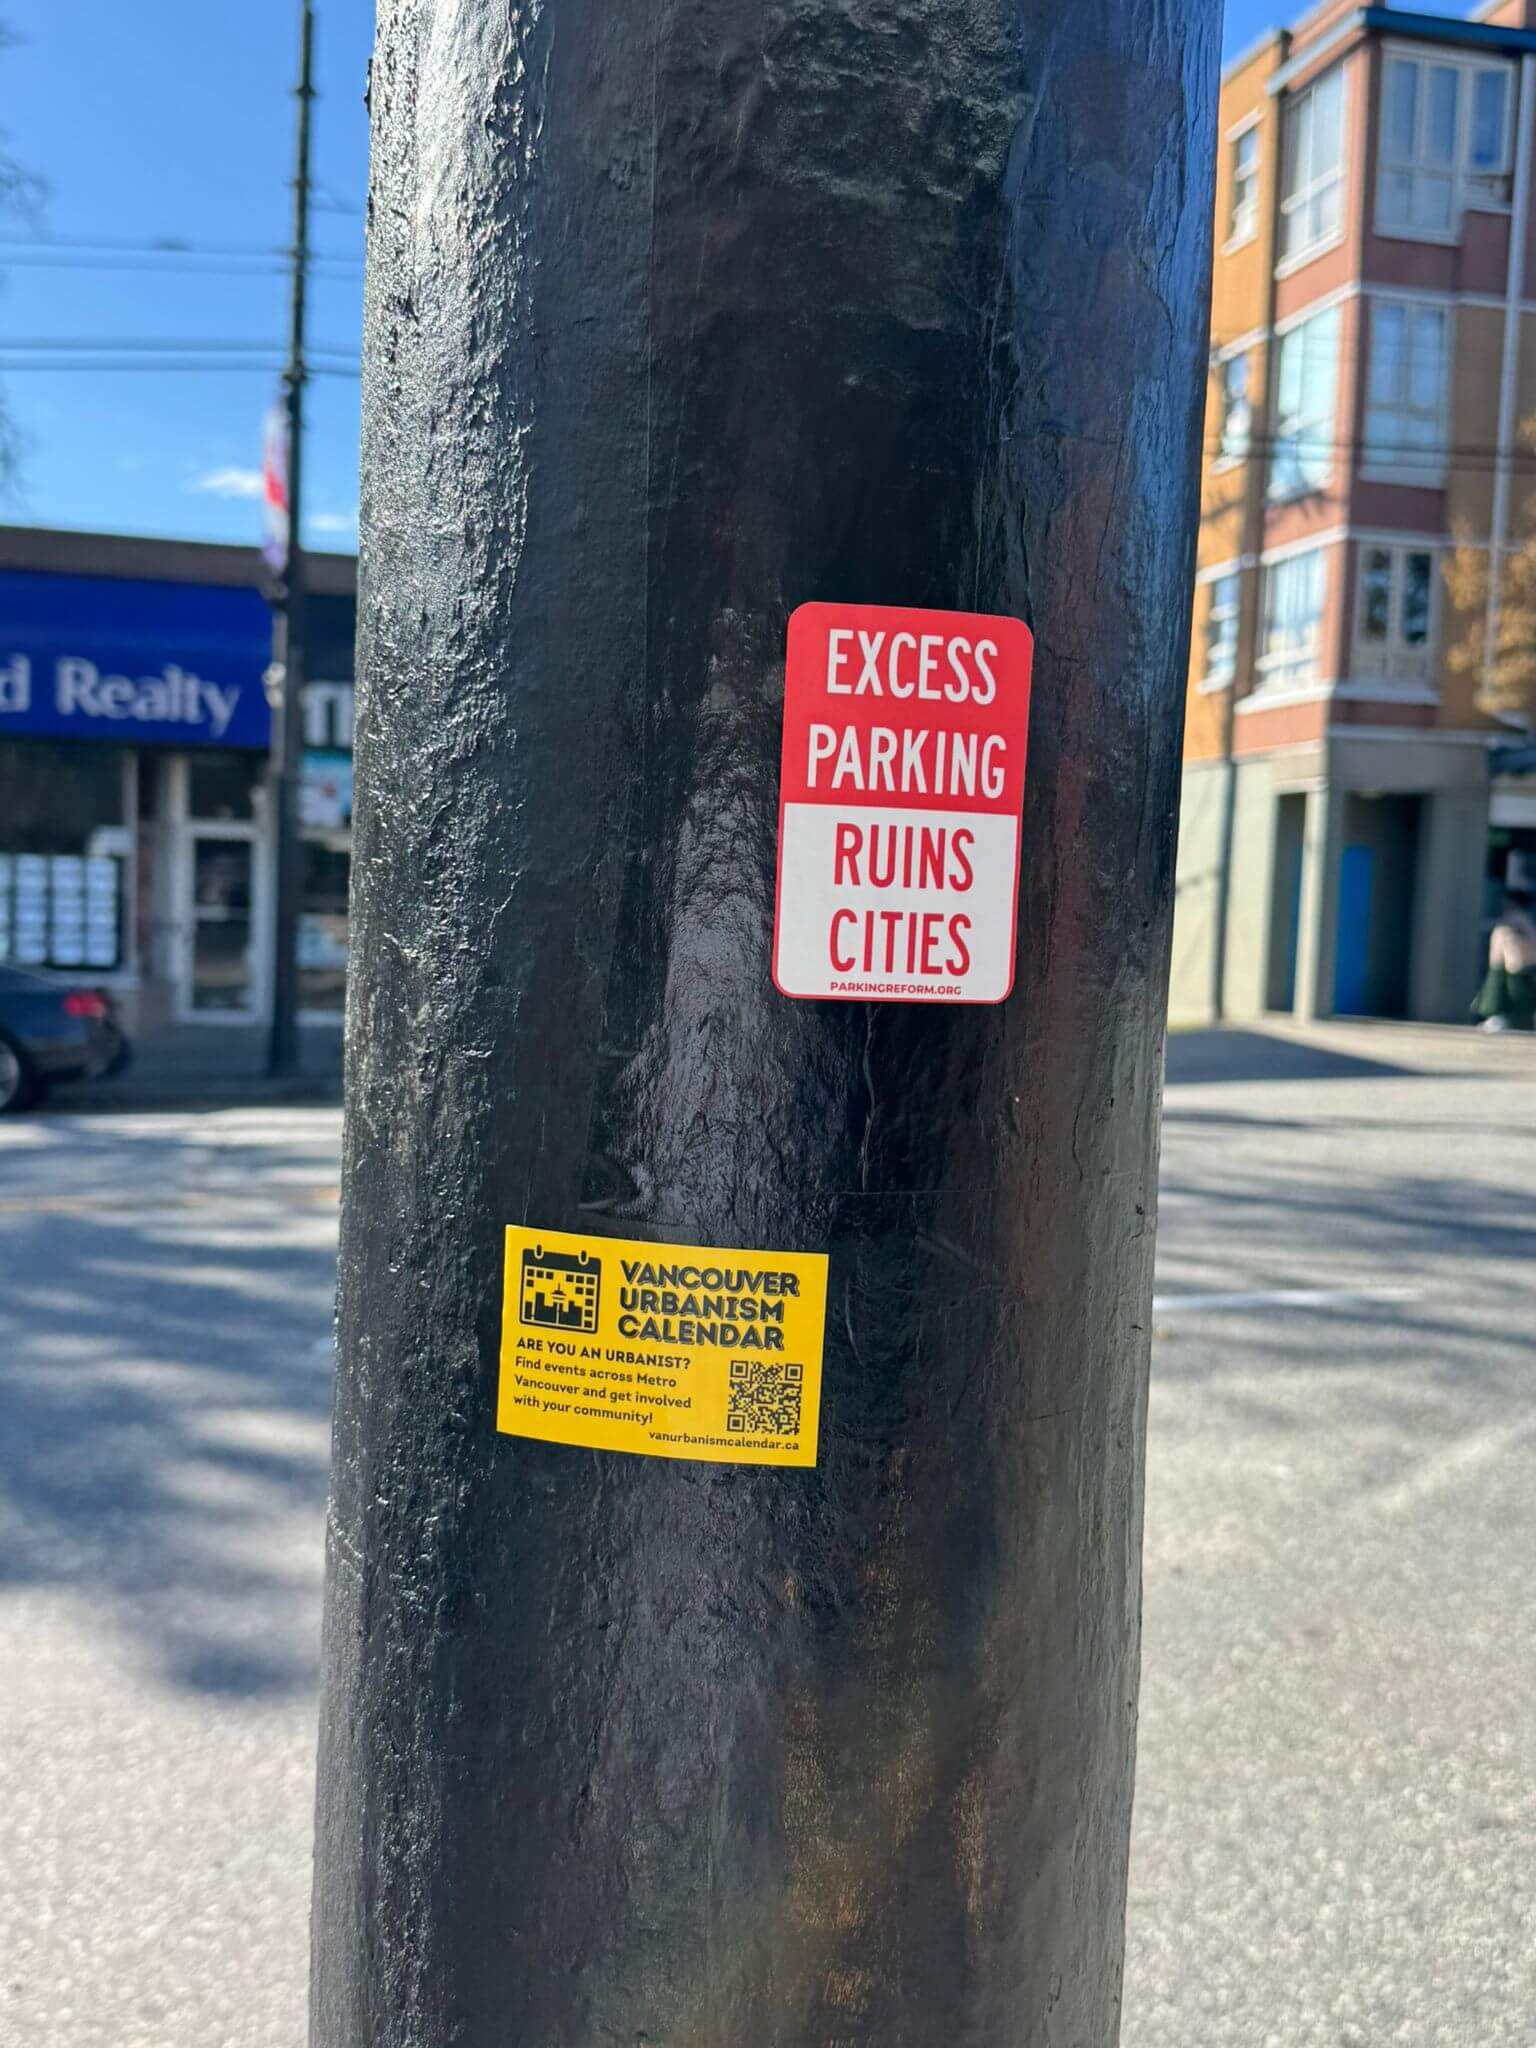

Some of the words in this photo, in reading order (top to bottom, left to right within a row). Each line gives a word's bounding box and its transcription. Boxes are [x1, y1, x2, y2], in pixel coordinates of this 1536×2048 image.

[826, 628, 998, 705] EXCESS
[55, 655, 242, 739] Realty
[806, 723, 1007, 799] PARKING
[833, 822, 975, 893] RUINS
[829, 908, 972, 977] CITIES
[830, 981, 962, 995] PARKINGREFORM.ORG
[620, 1259, 800, 1297] VANCOUVER
[620, 1287, 785, 1323] URBANISM
[617, 1314, 785, 1350] CALENDAR
[516, 1337, 543, 1351] ARE
[547, 1341, 576, 1356] YOU
[580, 1346, 601, 1359] AN
[606, 1348, 691, 1369] URBANIST?
[515, 1355, 541, 1370] Find
[544, 1362, 586, 1377] events
[589, 1367, 633, 1383] across
[636, 1372, 677, 1388] Metro
[514, 1374, 580, 1394] Vancouver
[582, 1387, 606, 1399] and
[610, 1391, 631, 1404] get
[635, 1391, 691, 1409] involved
[513, 1394, 540, 1408] with
[542, 1400, 571, 1413] your
[574, 1404, 653, 1426] community!
[648, 1431, 799, 1450] vanurbanismcalendar.ca
